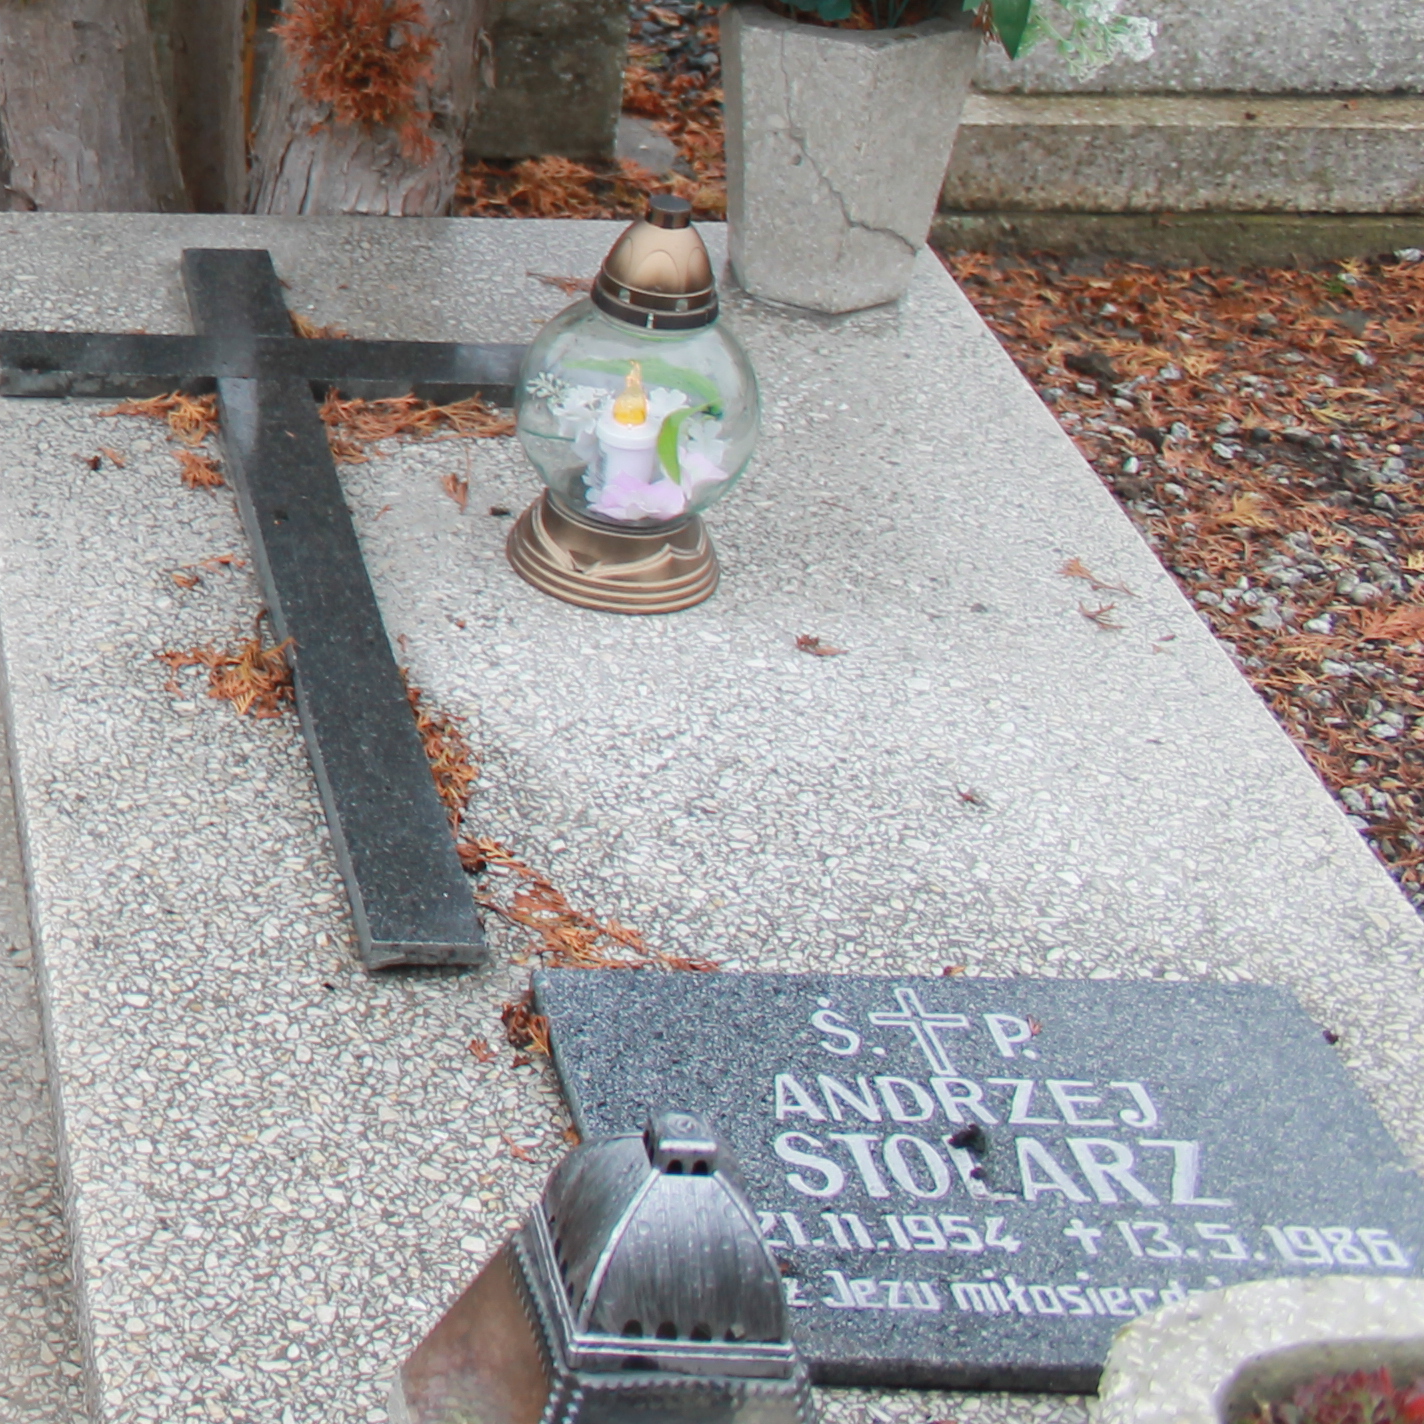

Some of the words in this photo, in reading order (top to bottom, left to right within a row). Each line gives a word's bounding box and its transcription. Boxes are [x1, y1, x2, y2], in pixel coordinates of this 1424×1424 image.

[774, 1072, 1159, 1129] ANDRZEJ
[773, 1130, 1235, 1208] STOLARZ
[1121, 1219, 1414, 1269] 13.5.1986
[822, 1269, 942, 1311] Jezu
